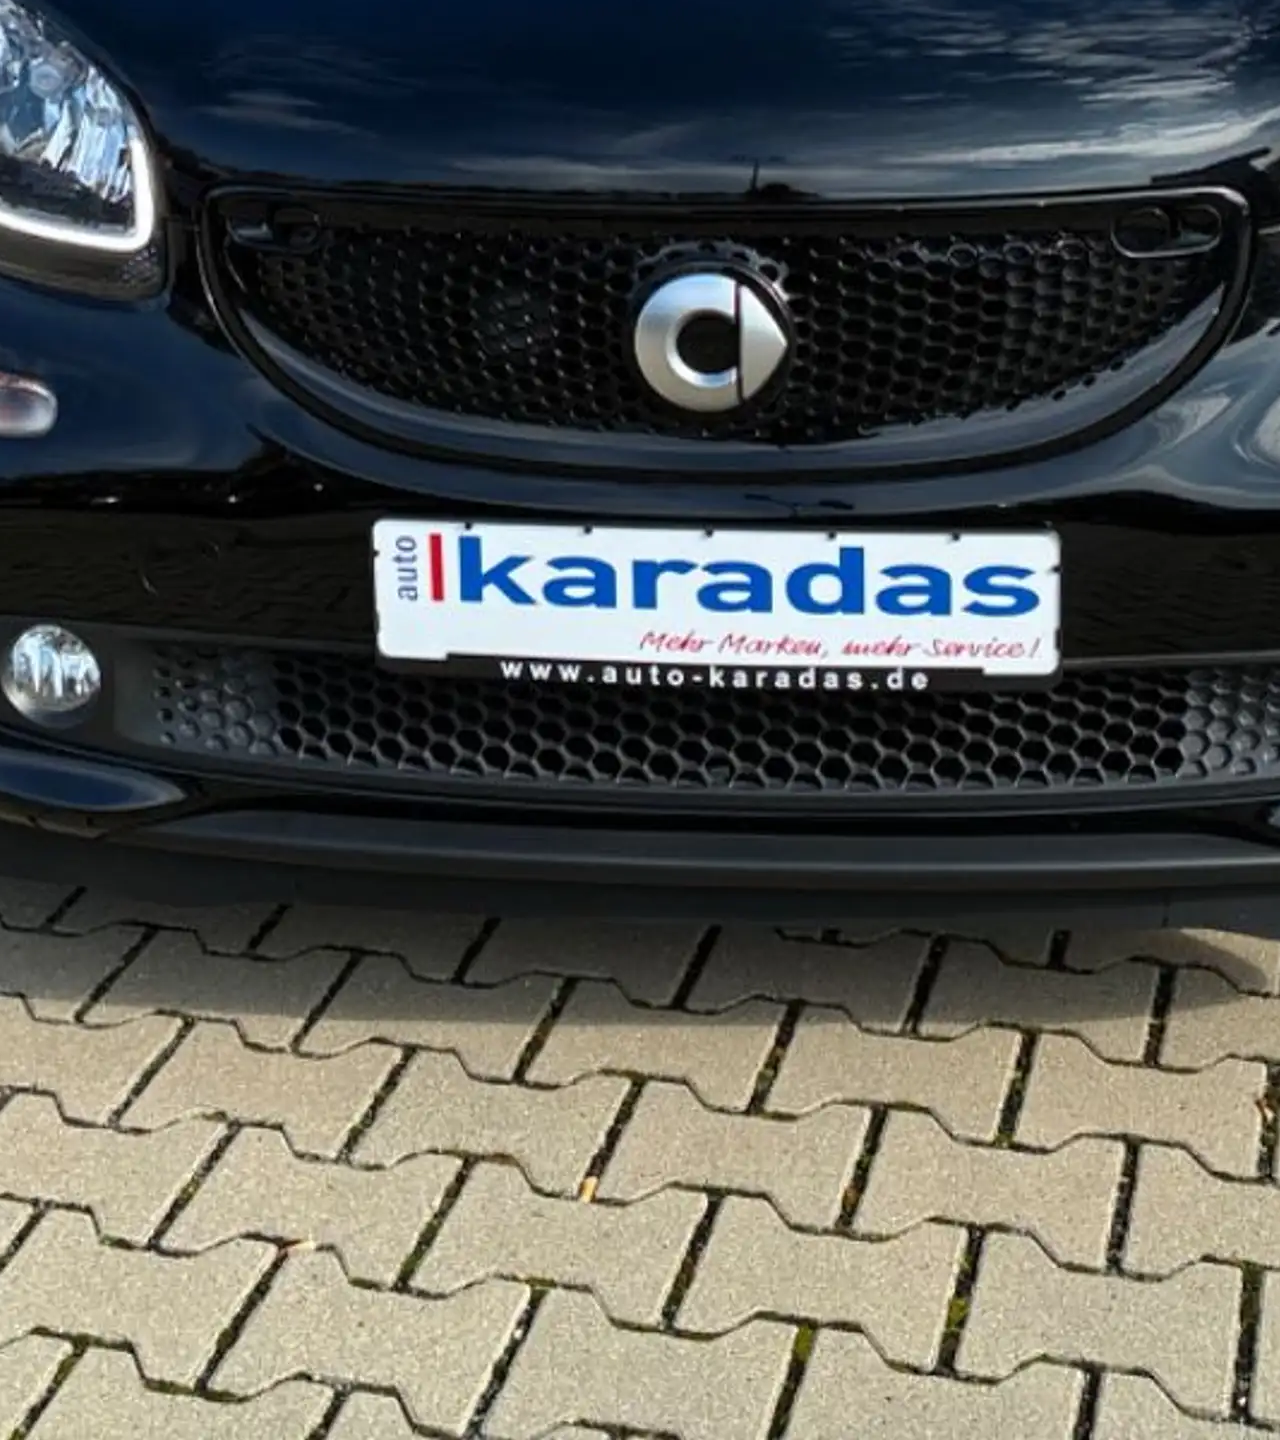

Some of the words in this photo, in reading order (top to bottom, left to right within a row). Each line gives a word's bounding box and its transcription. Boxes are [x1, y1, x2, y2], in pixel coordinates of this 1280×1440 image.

[393, 534, 419, 602] auto
[458, 535, 1041, 617] karadas
[639, 630, 712, 652] Mehr
[841, 634, 917, 657] mehr
[922, 636, 1042, 660] Service!
[500, 660, 929, 691] www.auto-karadas.de
